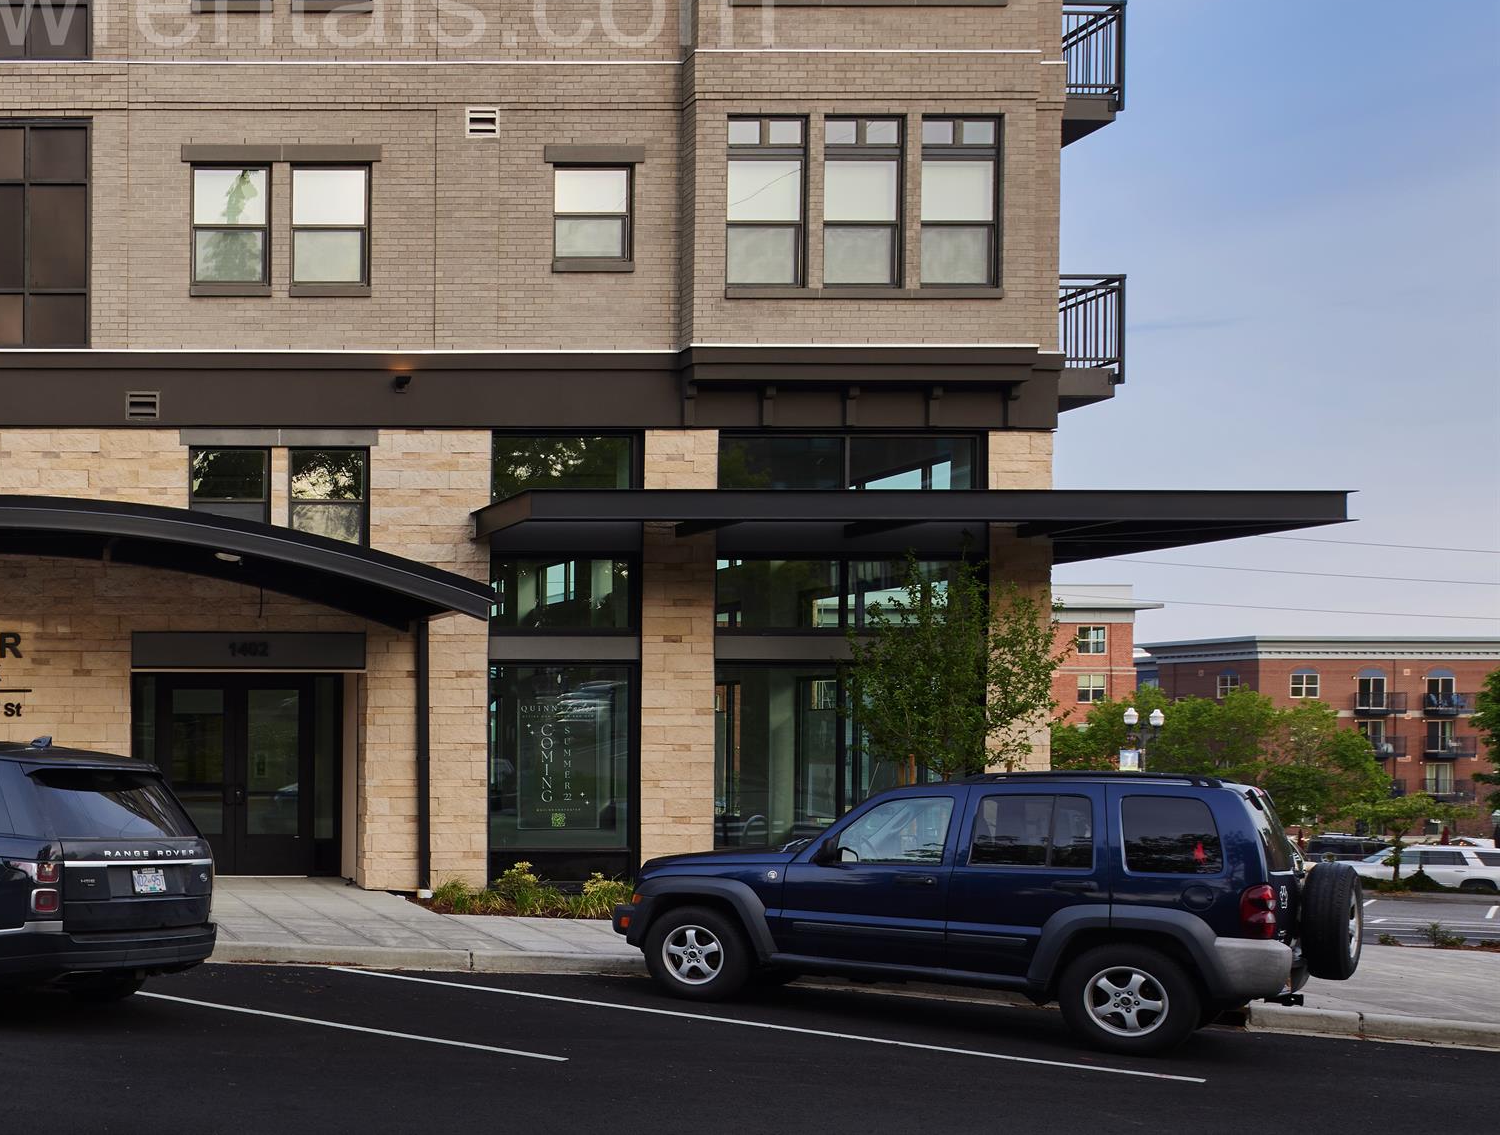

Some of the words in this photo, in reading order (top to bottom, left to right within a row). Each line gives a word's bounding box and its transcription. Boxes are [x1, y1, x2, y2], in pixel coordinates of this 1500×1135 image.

[4, 702, 22, 717] St
[541, 723, 553, 802] COMING
[563, 726, 571, 790] SUMMER
[157, 849, 195, 857] ROVER
